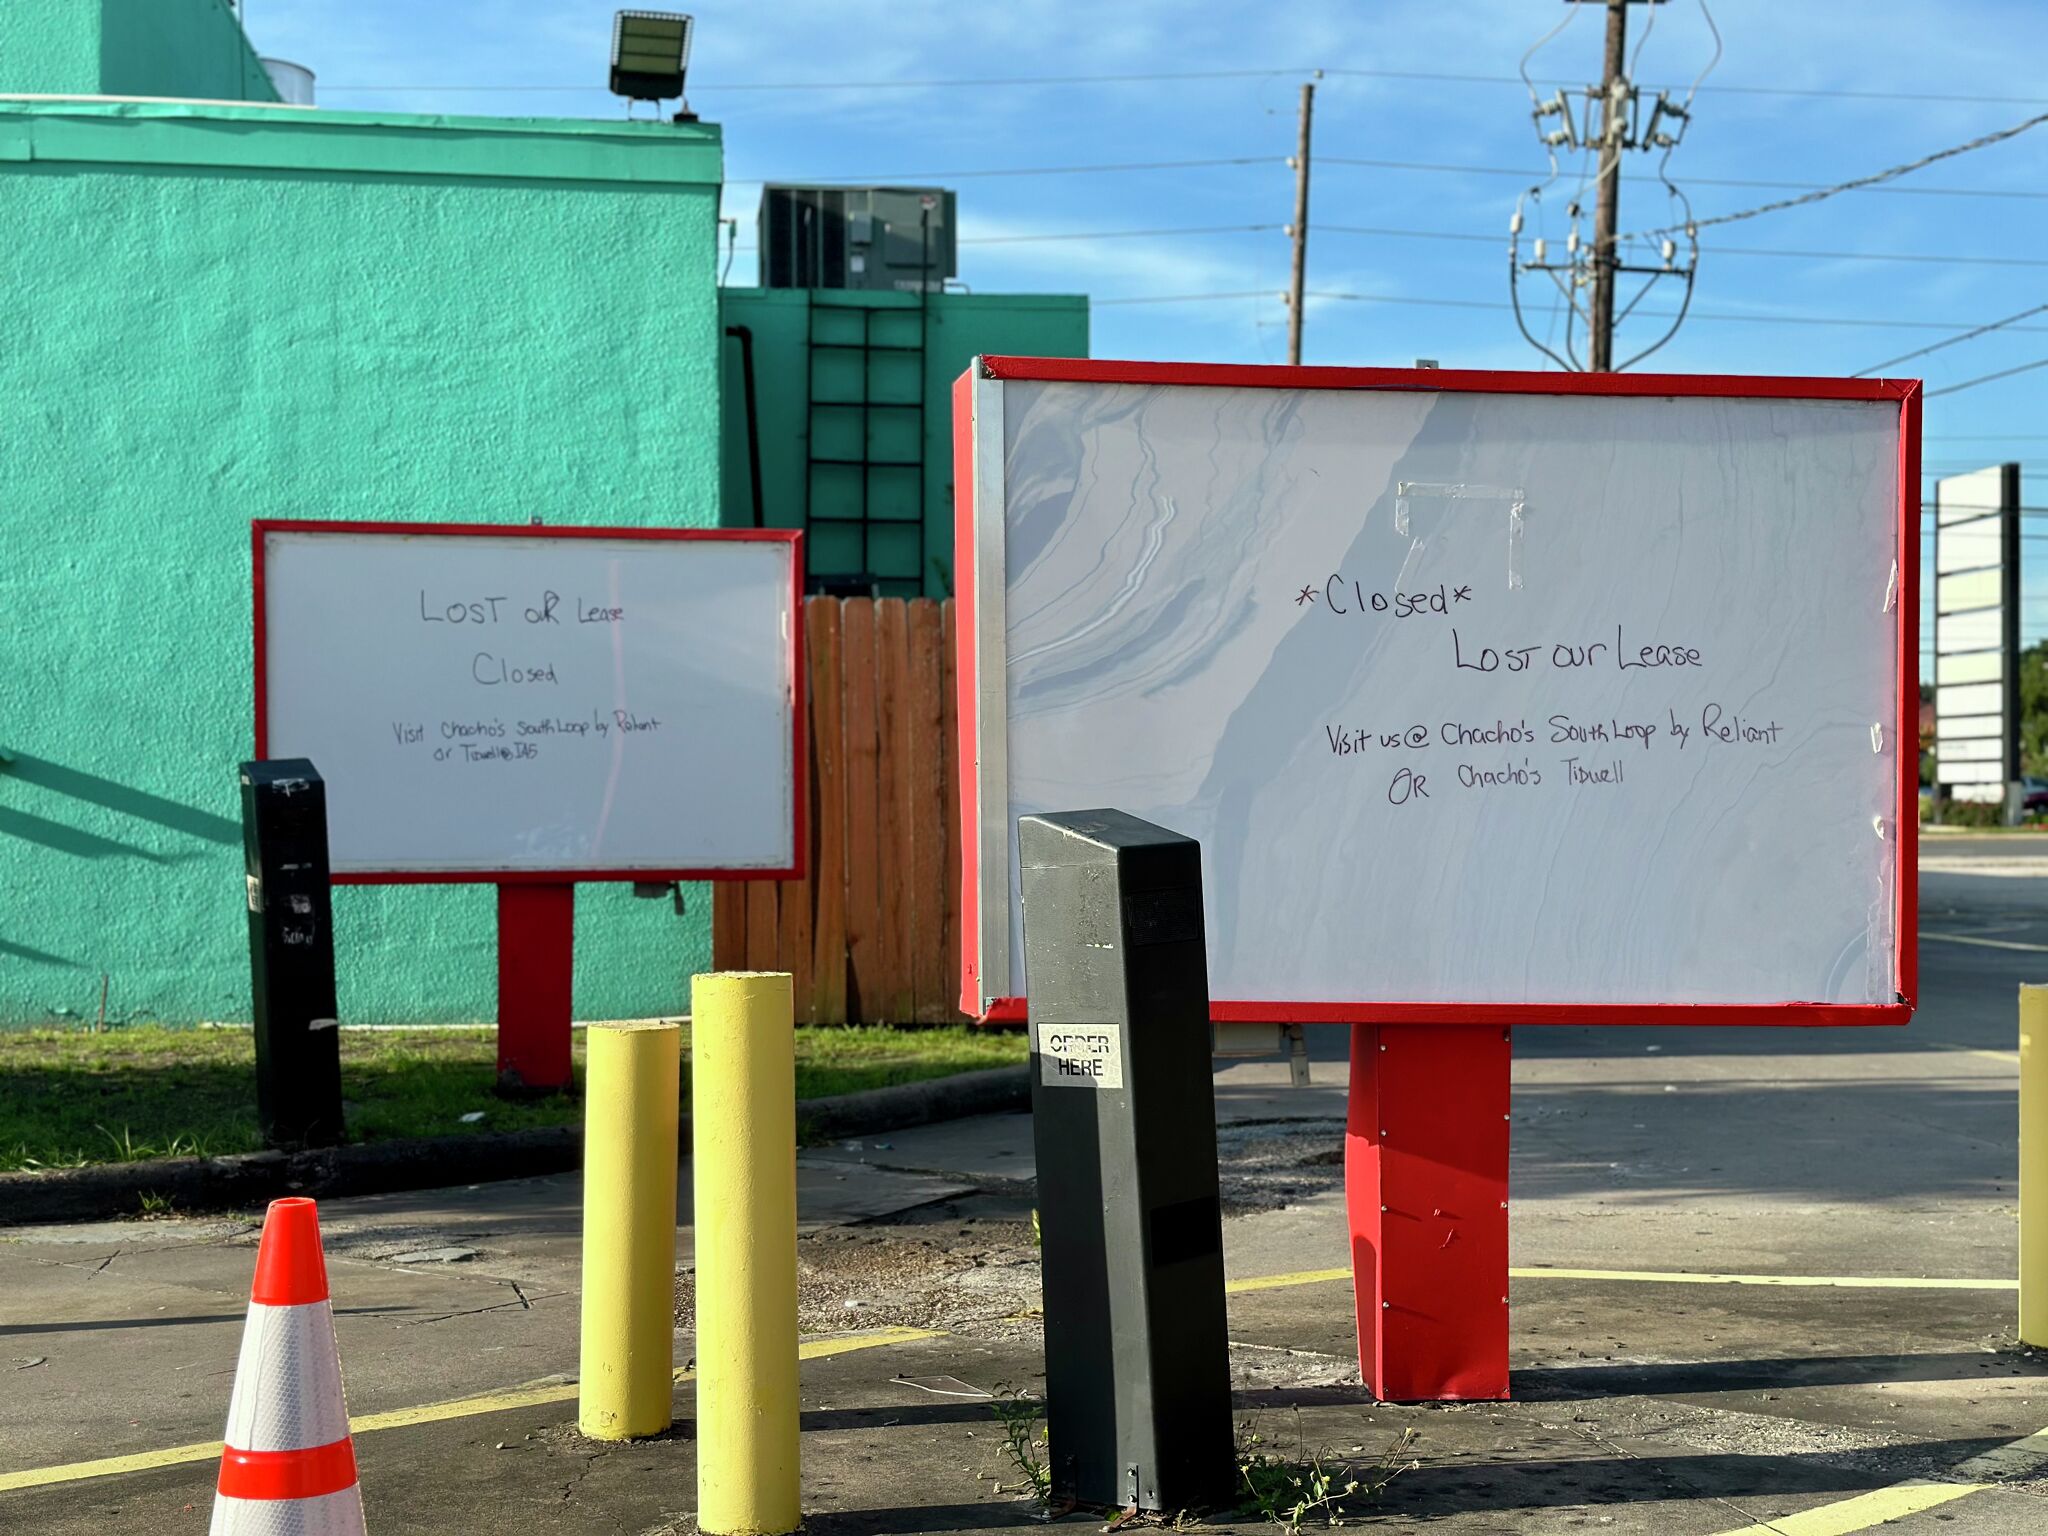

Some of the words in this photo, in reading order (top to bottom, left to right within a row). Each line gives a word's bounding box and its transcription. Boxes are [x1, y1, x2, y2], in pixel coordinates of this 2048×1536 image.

[1618, 624, 1703, 670] Lease
[472, 652, 559, 685] Closed
[1326, 724, 1372, 756] Visit
[1669, 708, 1690, 750] by
[1702, 702, 1784, 745] Reliant
[1388, 767, 1430, 805] OR
[1058, 1057, 1104, 1077] HERE
